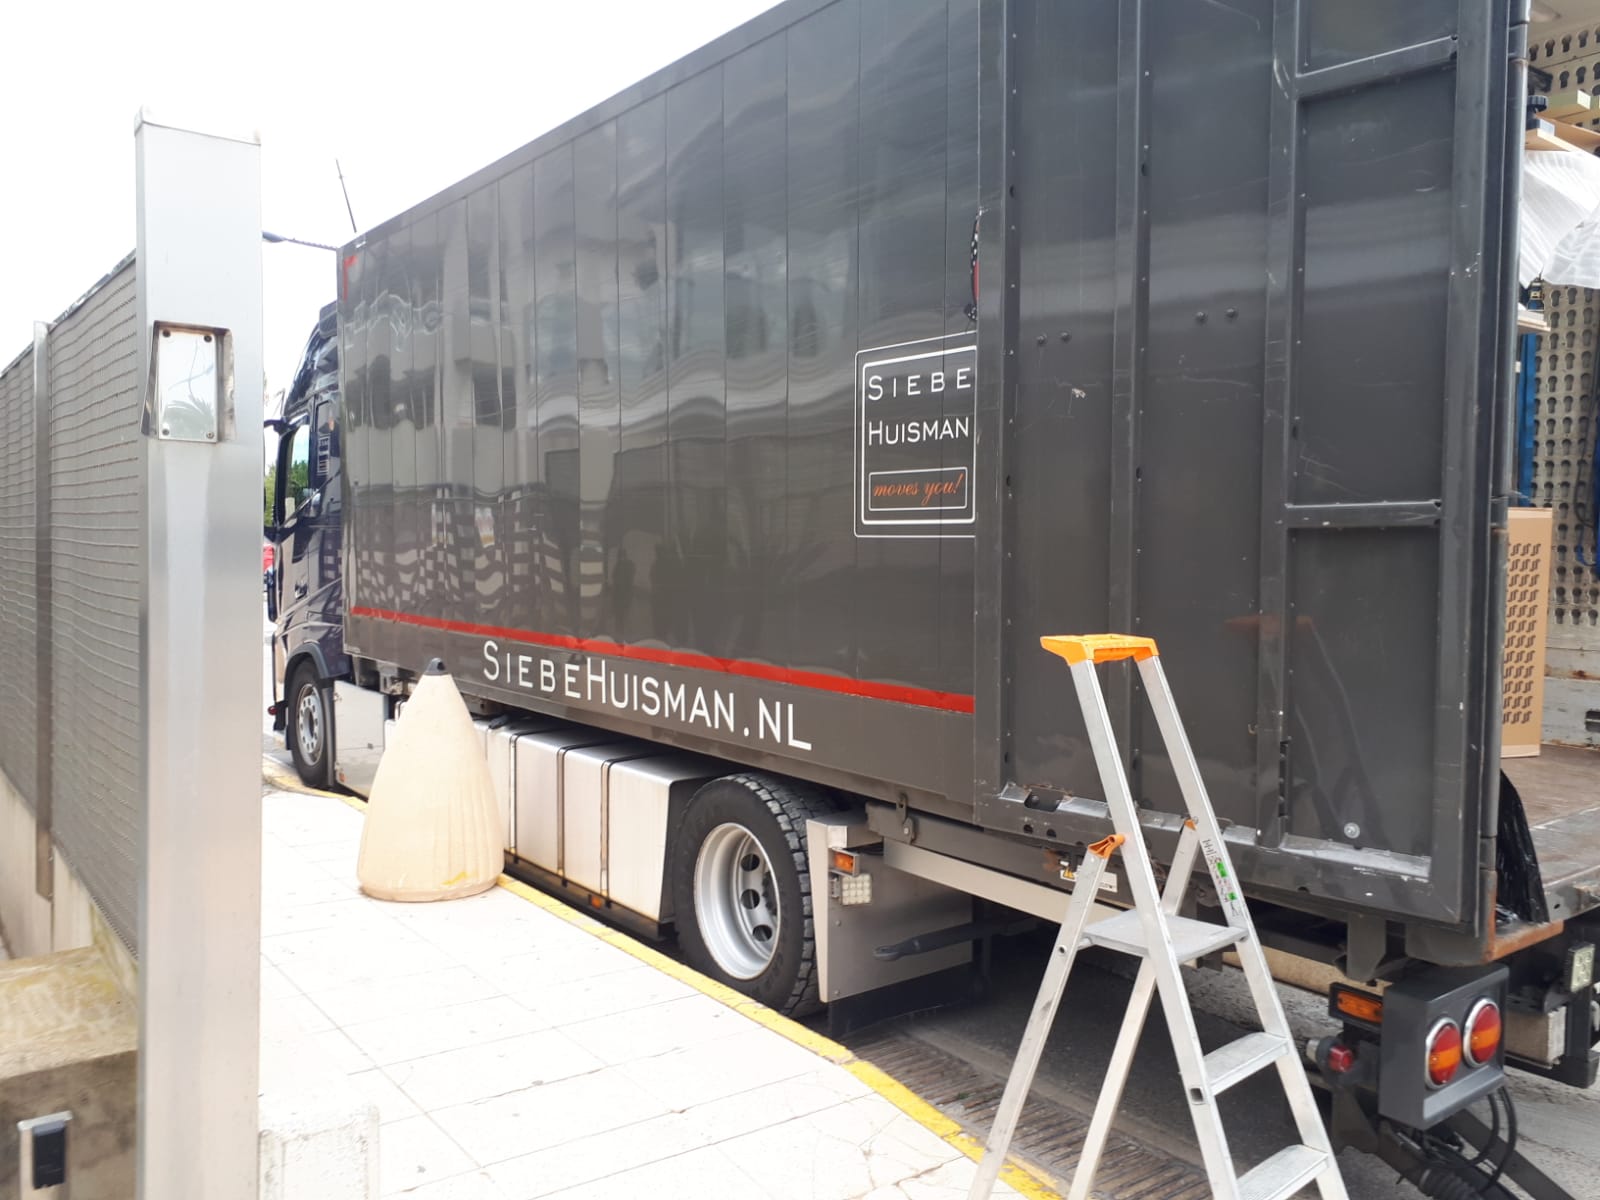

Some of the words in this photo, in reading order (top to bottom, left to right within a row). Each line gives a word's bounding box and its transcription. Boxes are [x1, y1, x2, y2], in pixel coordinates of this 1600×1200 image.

[868, 367, 971, 400] SIEBE
[868, 417, 969, 446] HUISMAN
[873, 481, 919, 497] moves
[922, 473, 964, 506] you!
[483, 640, 812, 751] SIEBEHUISMAN.NL
